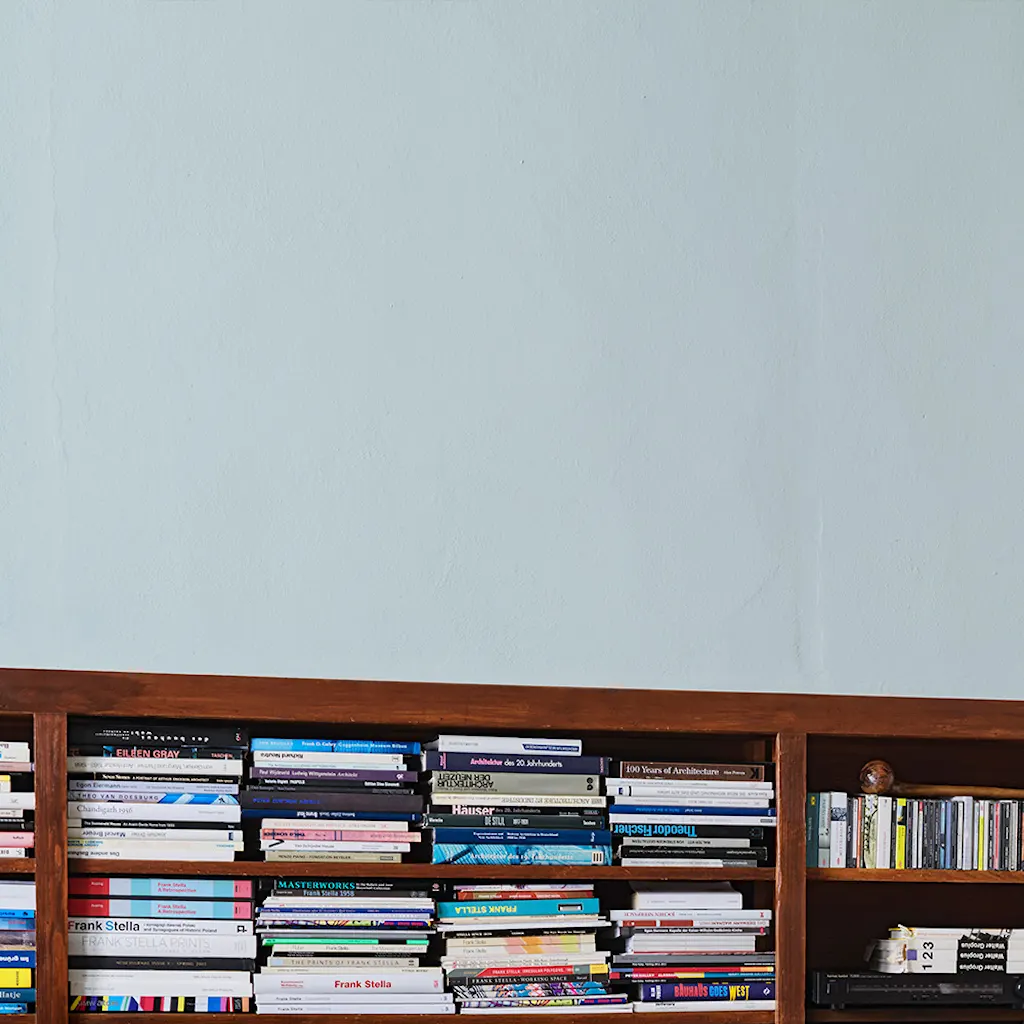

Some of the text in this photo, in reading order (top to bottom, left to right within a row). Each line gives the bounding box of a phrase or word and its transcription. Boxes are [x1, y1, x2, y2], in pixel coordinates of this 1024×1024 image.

[116, 748, 180, 758] EILEEN GRAY
[625, 765, 719, 775] 100 Years of Architecture
[437, 780, 493, 788] ARCHITEKTUR
[452, 805, 495, 815] Häuser
[614, 824, 697, 837] Theodor Fischer
[278, 880, 355, 890] MASTERWORKS
[68, 921, 140, 932] Frank Stella
[82, 937, 210, 948] FRANK STELLA PRINTS
[709, 983, 728, 997] GOES
[729, 985, 750, 1000] WEST
